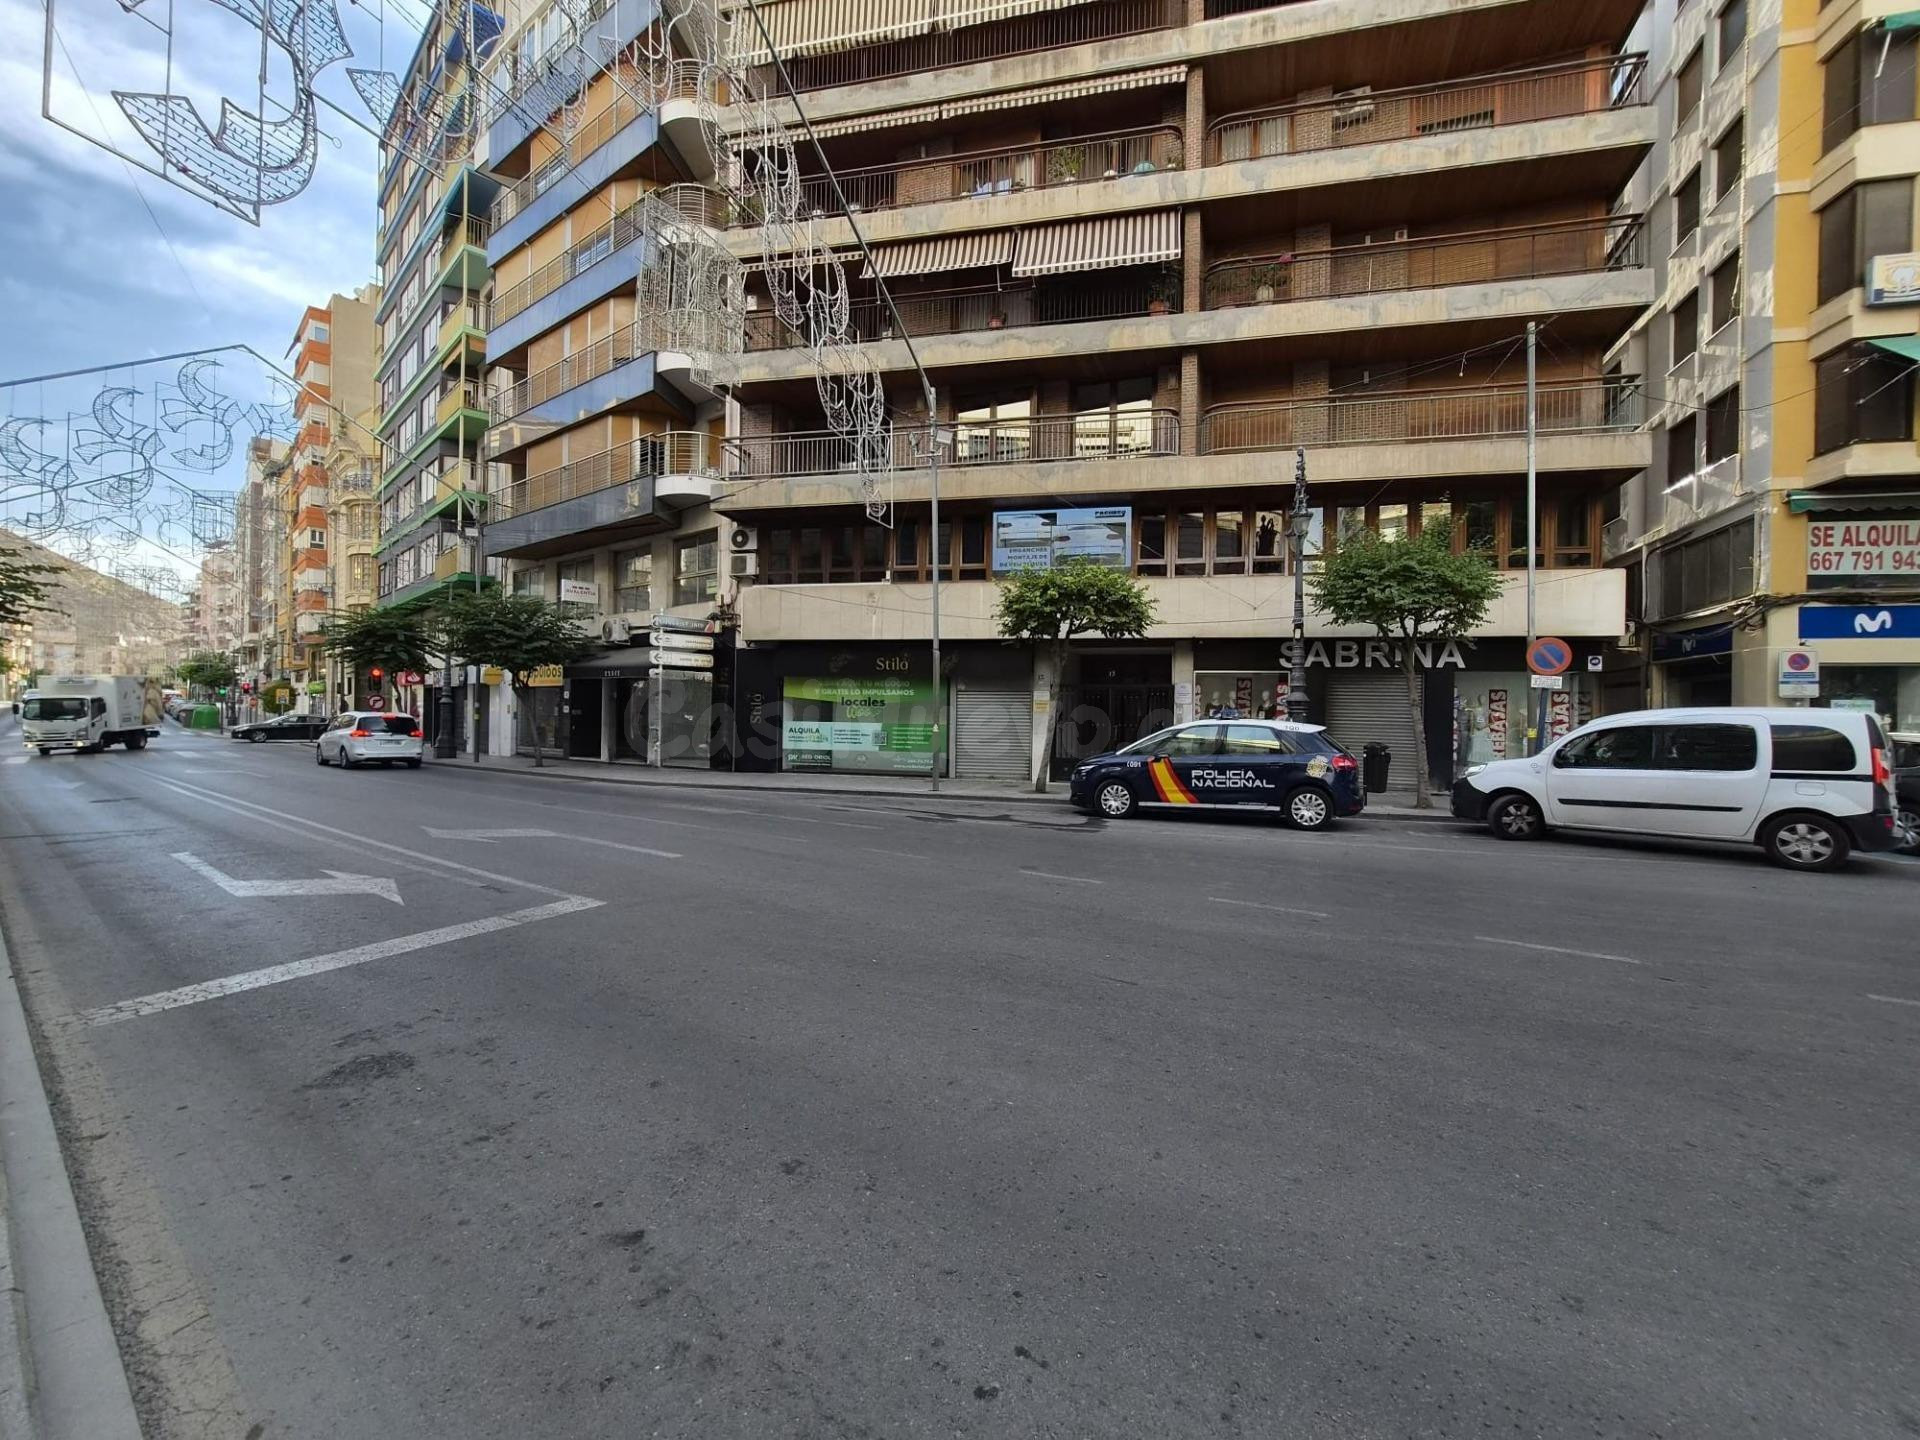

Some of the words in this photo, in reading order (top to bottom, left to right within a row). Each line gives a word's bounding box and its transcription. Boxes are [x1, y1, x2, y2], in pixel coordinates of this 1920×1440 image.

[1810, 526, 1834, 547] SE
[1810, 551, 1843, 571] 667
[1852, 550, 1883, 570] 791
[841, 696, 887, 707] locales
[788, 727, 820, 735] ALQUILA
[1191, 768, 1255, 779] POLICÍA
[1191, 779, 1275, 788] NACIONAL
